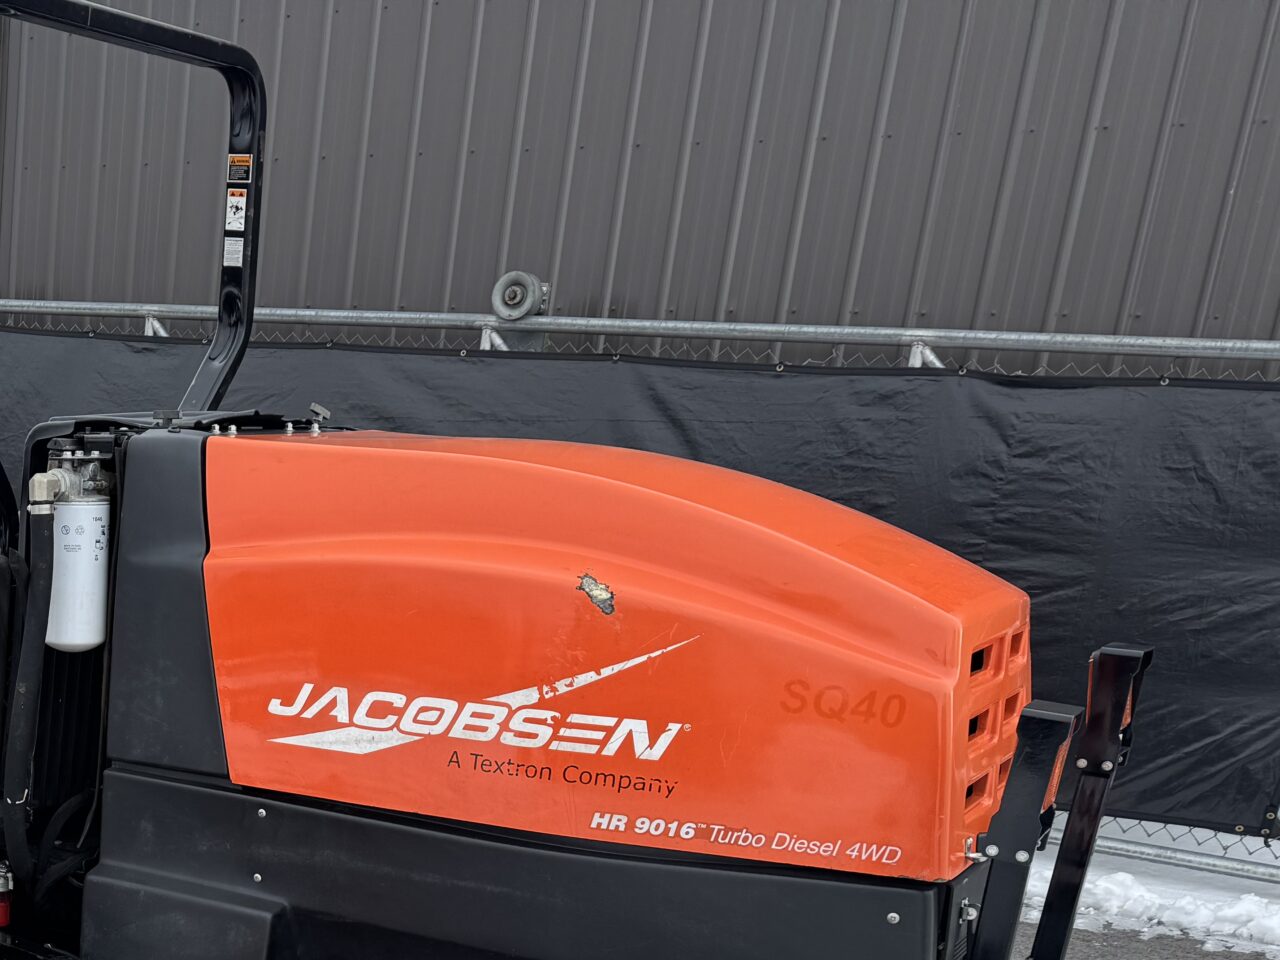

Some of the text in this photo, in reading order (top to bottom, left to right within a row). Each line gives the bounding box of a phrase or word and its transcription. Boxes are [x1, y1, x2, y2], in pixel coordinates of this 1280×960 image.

[267, 683, 683, 761] JACOBSEN
[780, 679, 907, 729] SQ40
[447, 750, 679, 799] A Textron Company
[590, 811, 629, 832] HR
[708, 825, 766, 848] Turbo
[771, 832, 840, 857] Diesel
[846, 842, 902, 865] 4WD
